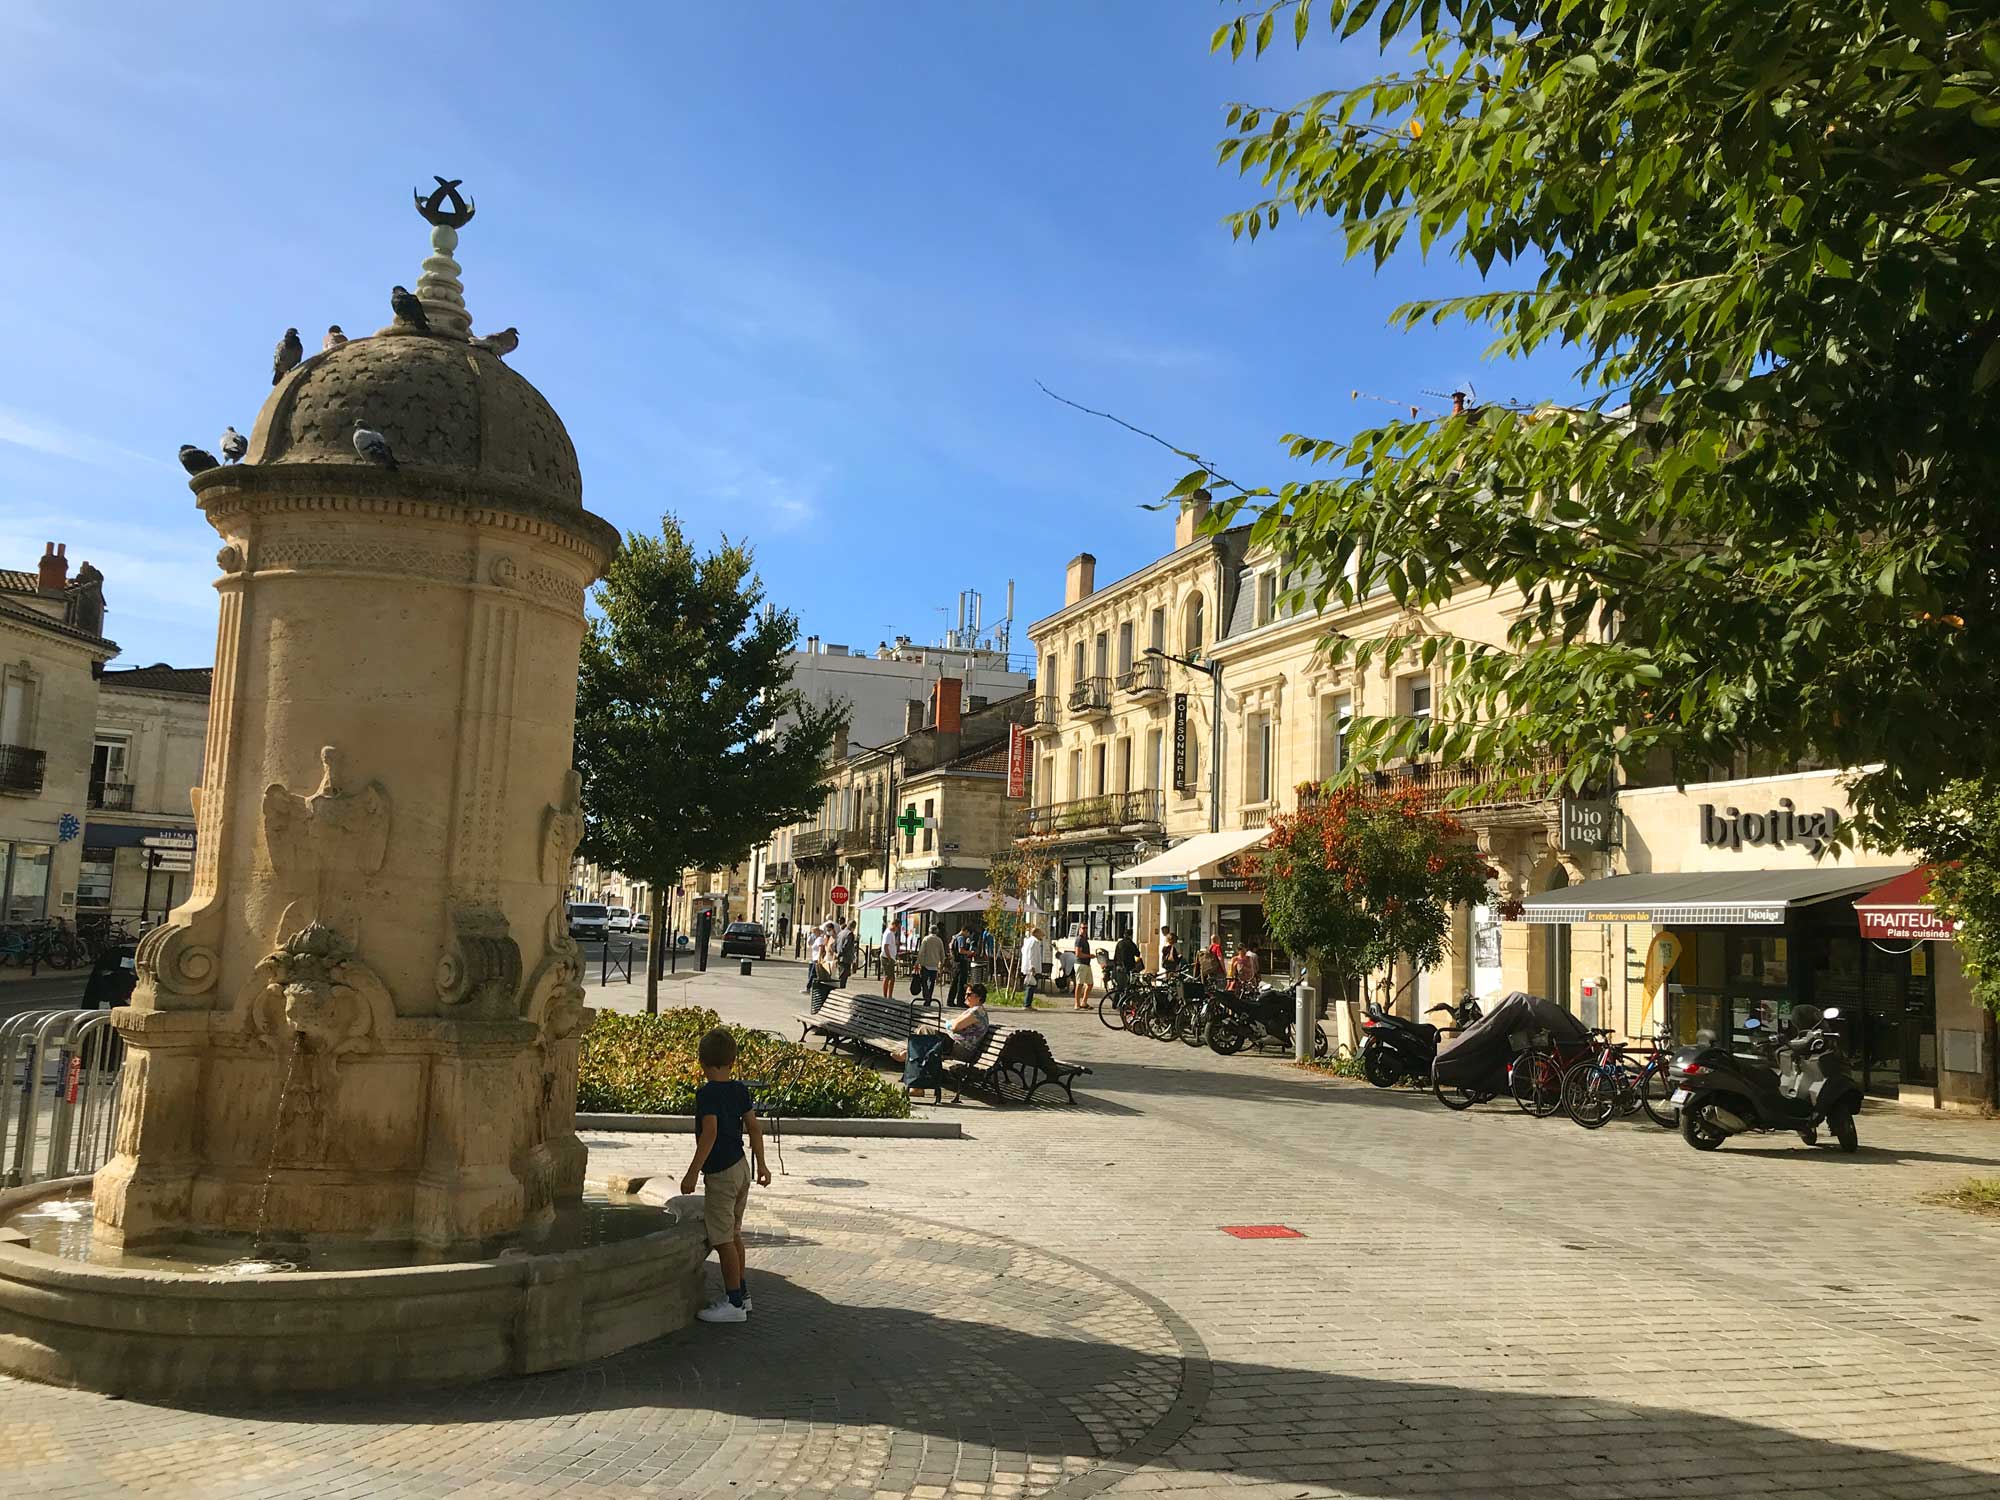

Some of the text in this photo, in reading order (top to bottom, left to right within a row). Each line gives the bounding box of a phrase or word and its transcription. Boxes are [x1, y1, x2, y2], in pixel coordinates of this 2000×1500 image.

[1012, 724, 1023, 773] PIZZERIA
[1177, 697, 1186, 788] POISSONNERIE
[1571, 805, 1602, 826] bio
[1212, 880, 1245, 891] Boulanger
[1864, 912, 1944, 928] TRAITEUR
[1887, 928, 1951, 938] Plats cuisinés
